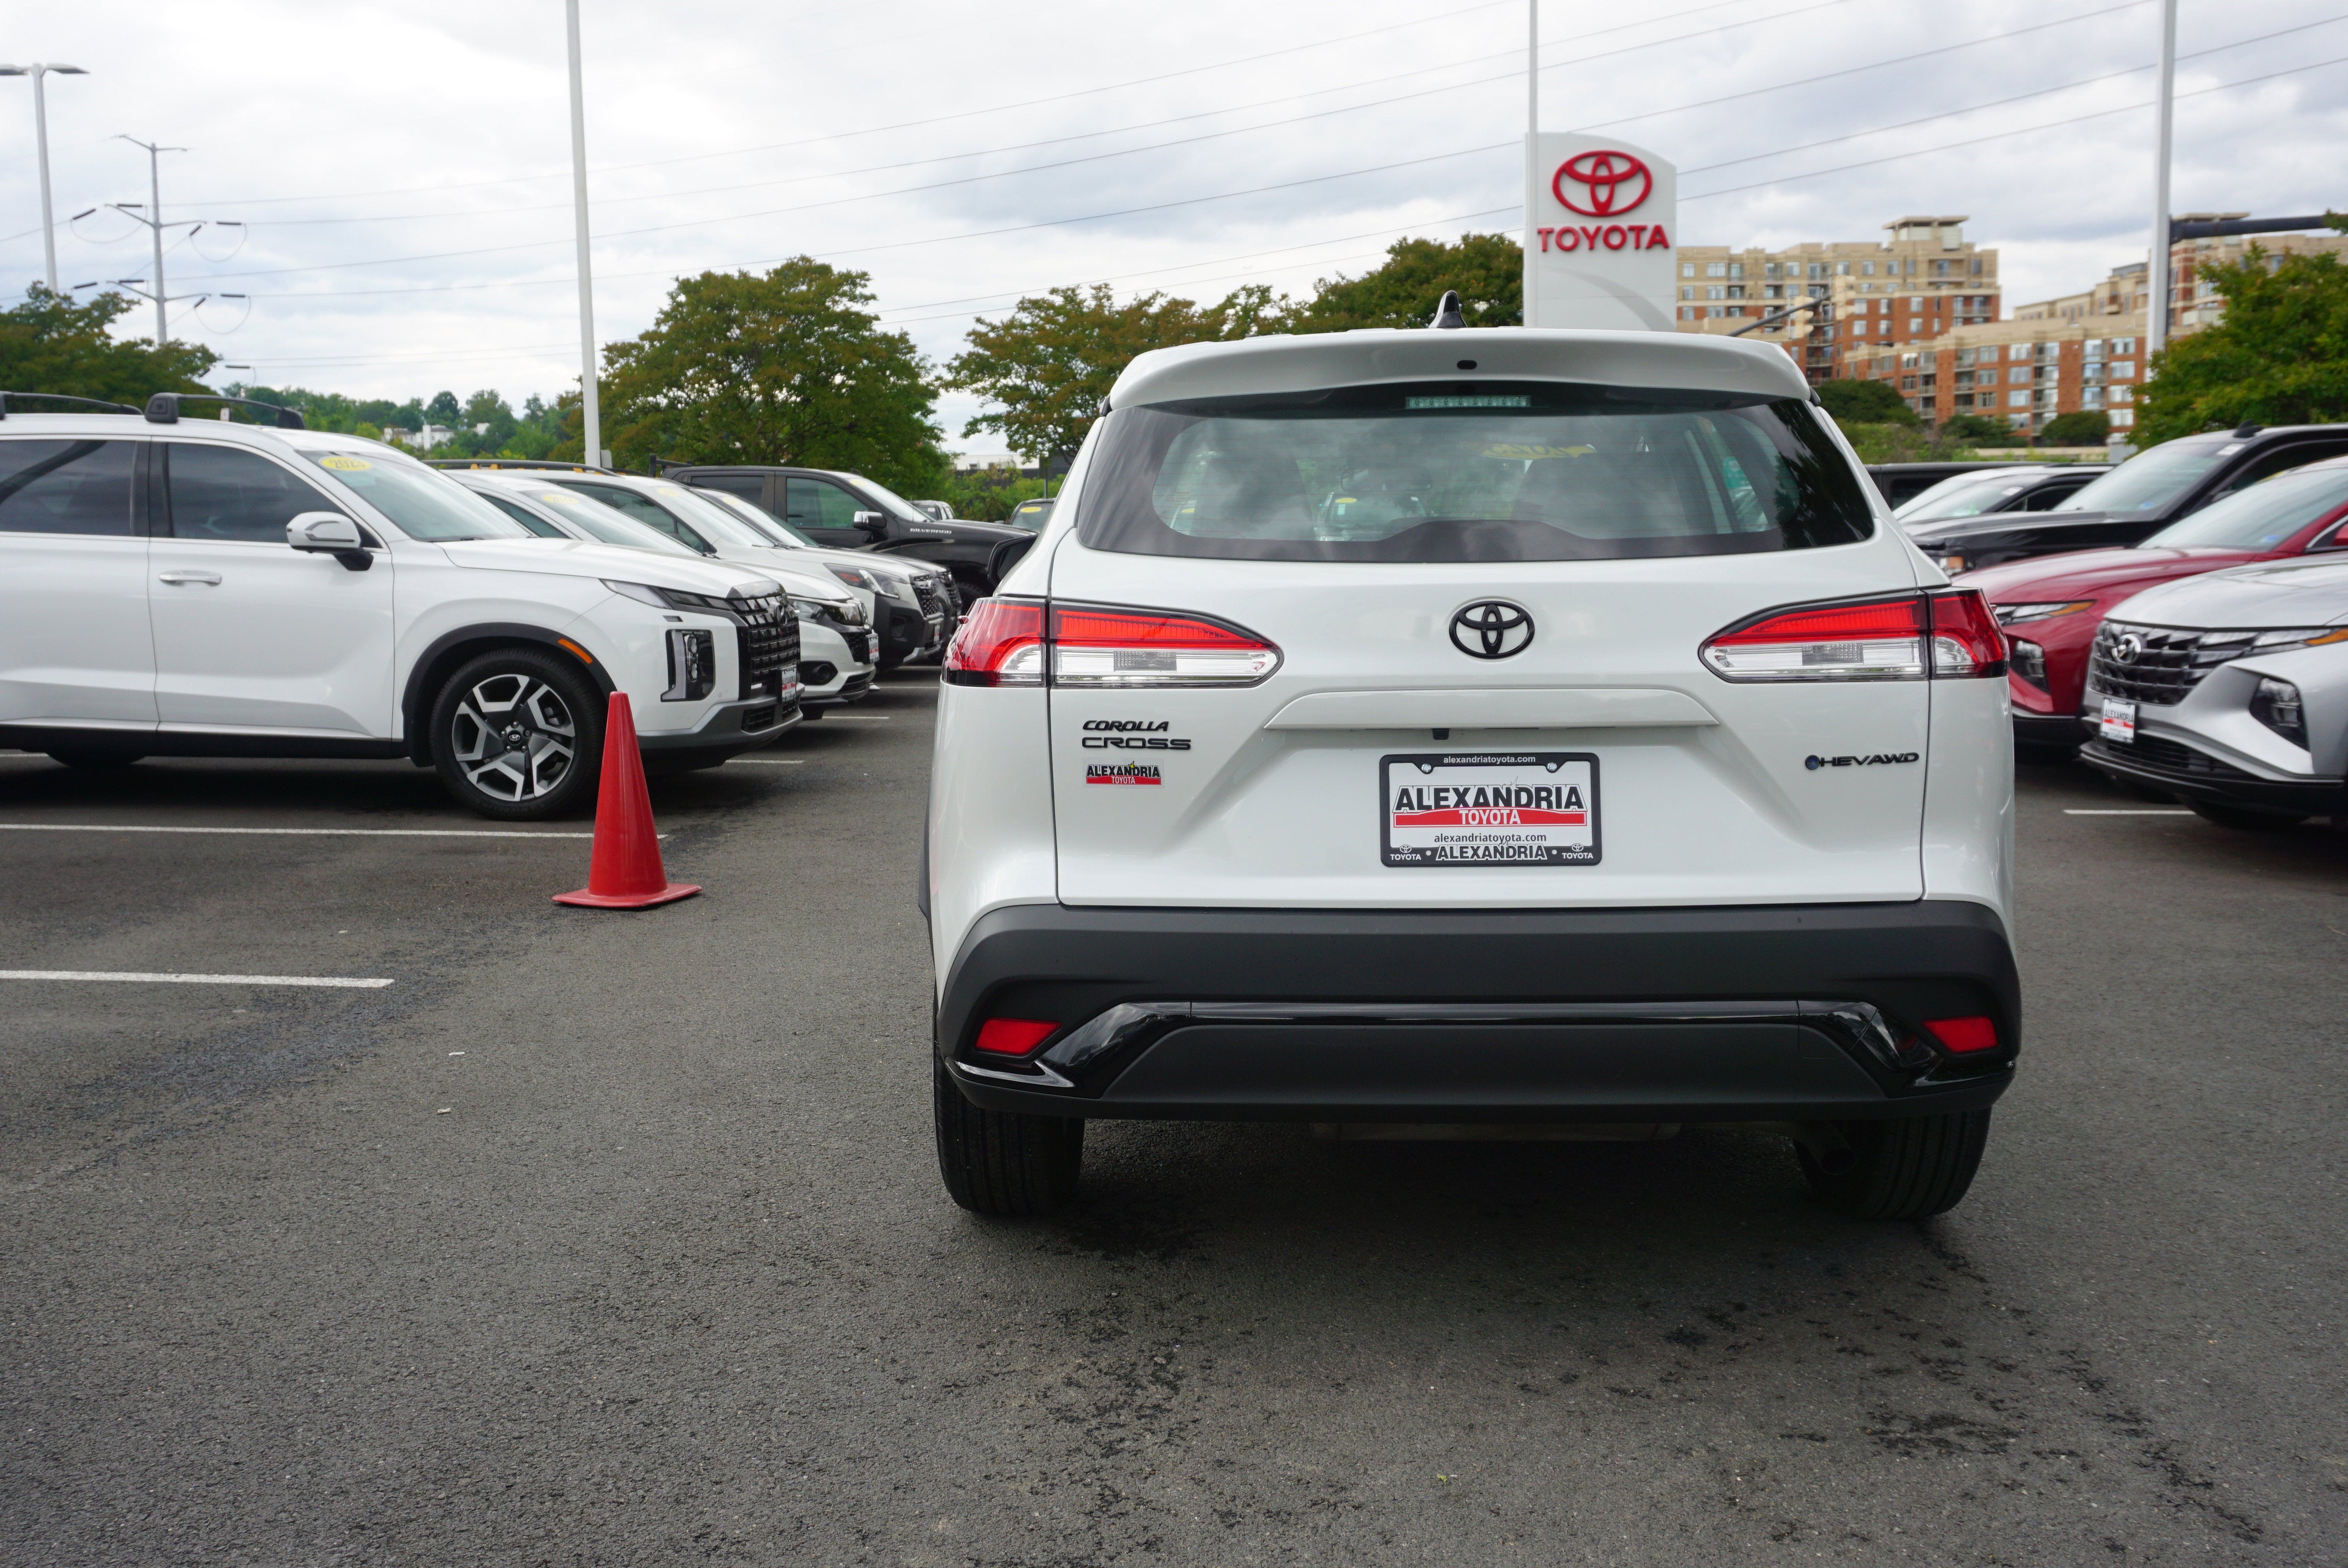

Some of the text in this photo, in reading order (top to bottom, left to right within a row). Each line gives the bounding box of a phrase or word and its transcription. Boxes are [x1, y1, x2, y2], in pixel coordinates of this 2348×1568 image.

[1537, 224, 1670, 252] TOYOTA
[1082, 720, 1169, 732] COROLLA
[1082, 737, 1191, 750] CROSS
[1443, 755, 1536, 764] alexandriatoyota.com
[1086, 765, 1161, 778] ALEXANDRIA
[1394, 786, 1586, 811] ALEXANDRIA
[1459, 809, 1521, 824] TOYOTA
[1434, 833, 1547, 844] alexandriatoyota.com
[1436, 844, 1548, 860] ALEXANDRIA
